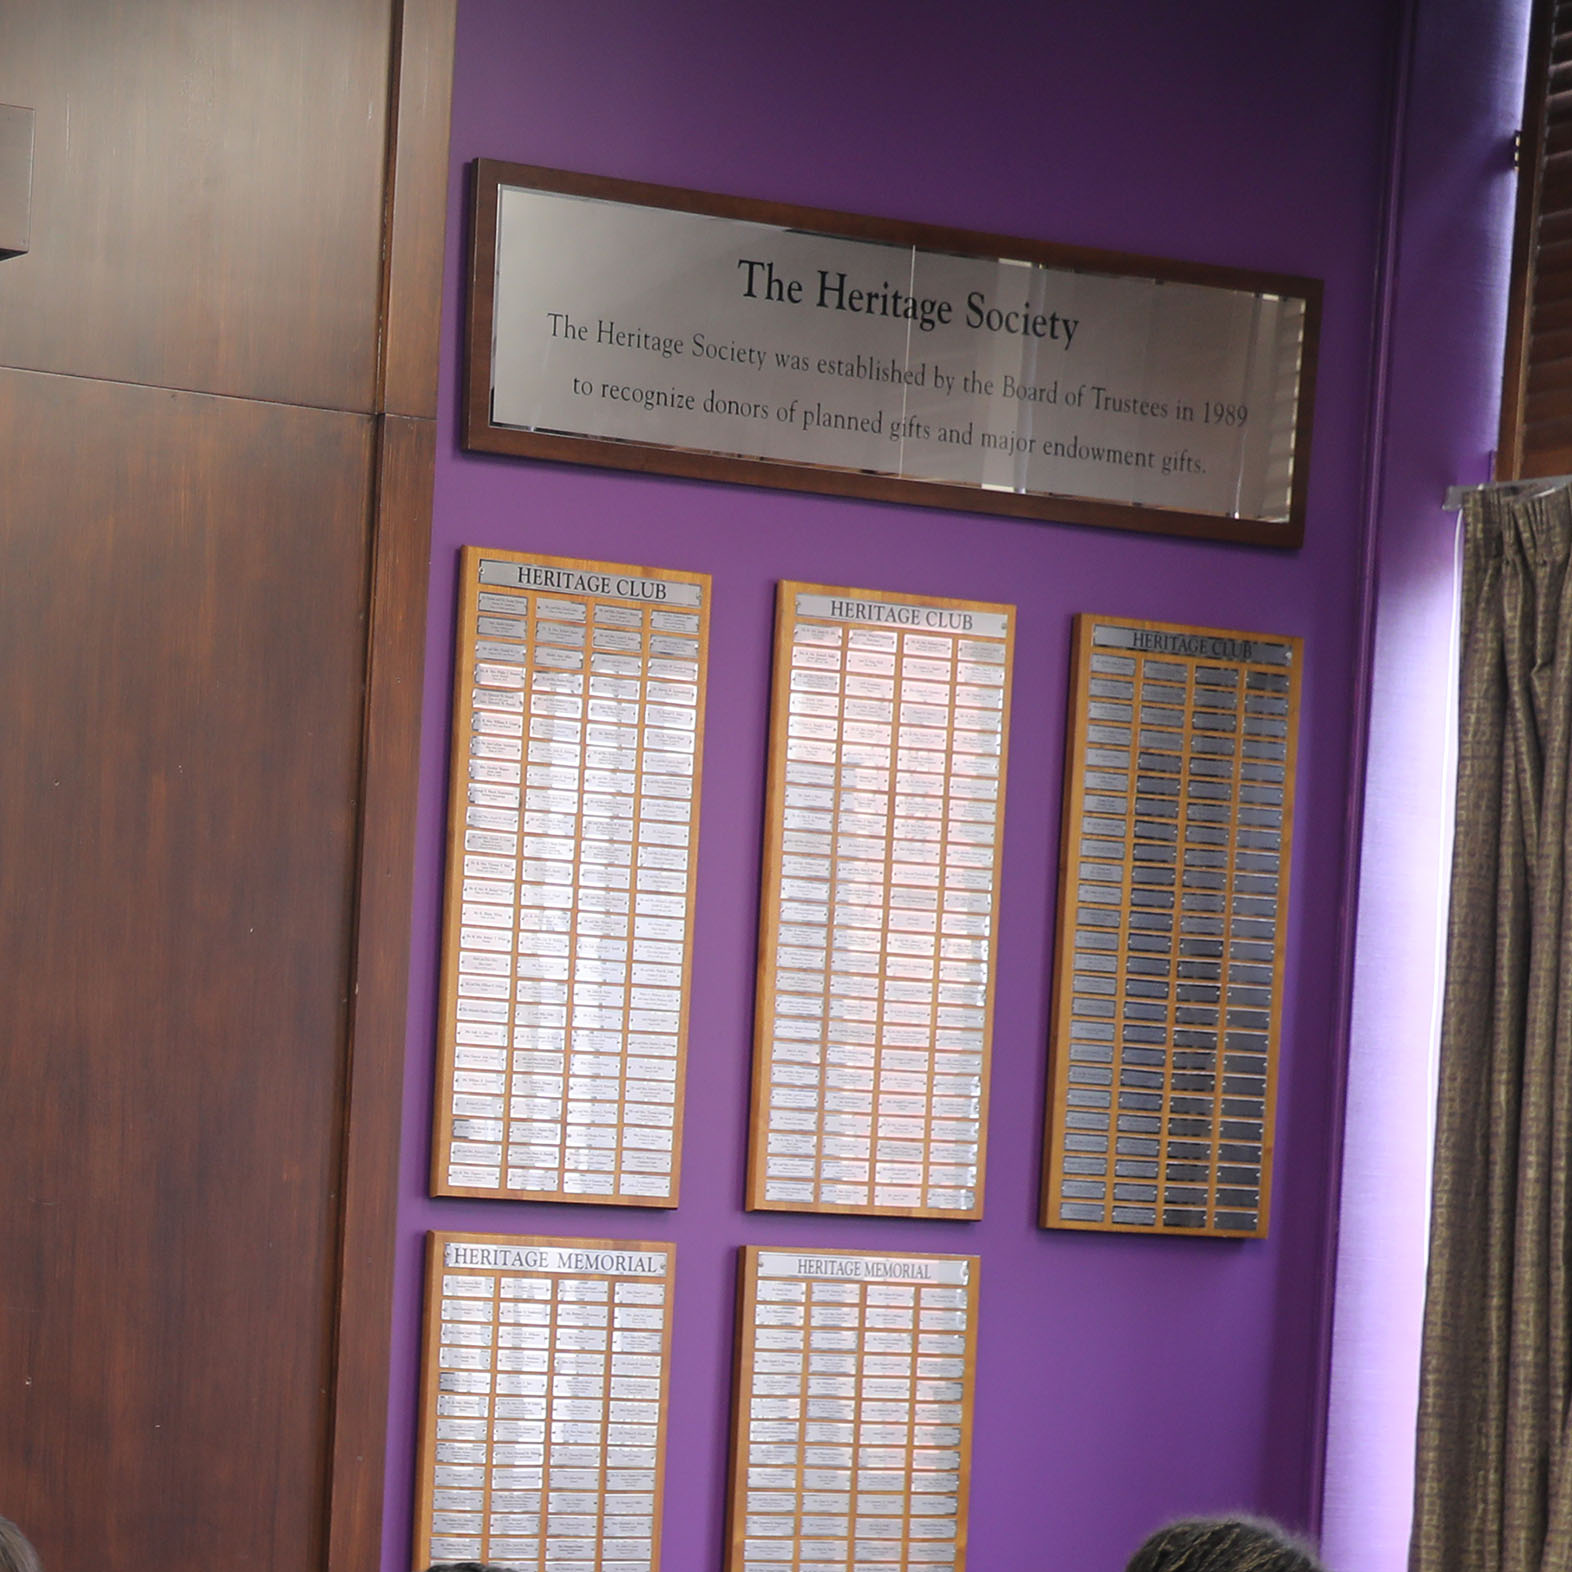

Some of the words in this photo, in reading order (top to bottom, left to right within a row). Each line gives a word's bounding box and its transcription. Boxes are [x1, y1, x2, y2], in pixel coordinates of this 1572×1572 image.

[738, 259, 803, 304] The
[816, 270, 953, 332] Heritage
[966, 291, 1080, 350] Society
[547, 312, 588, 342] The
[597, 319, 684, 359] Heritage
[691, 332, 767, 371] Society
[775, 353, 810, 372] was
[817, 354, 926, 387] established
[934, 365, 956, 395] by
[962, 370, 994, 396] the
[1002, 374, 1058, 404] Board
[1064, 384, 1087, 408] of
[1091, 386, 1168, 419] Trustees
[1176, 400, 1195, 422] in
[1202, 401, 1249, 428] 1989
[573, 376, 593, 396] to
[600, 382, 695, 411] recognize
[702, 389, 769, 420] donors
[776, 400, 800, 424] of
[802, 402, 884, 435] planned
[889, 415, 931, 442] gifts
[937, 422, 973, 447] and
[980, 429, 1037, 457] major
[1043, 435, 1156, 470] endowment
[1161, 449, 1207, 475] gifts.
[517, 566, 612, 595] HERITAGE
[615, 578, 668, 601] CLUB
[830, 600, 921, 626] HERITAGE
[925, 609, 974, 631] CLUB
[1132, 631, 1206, 655] HERITAGE
[1211, 638, 1254, 659] CLUB
[454, 1247, 550, 1269] HERITAGE
[557, 1251, 658, 1274] MEMORIAL
[797, 1258, 862, 1278] HERITAGE
[864, 1261, 932, 1280] MEMORIAL
